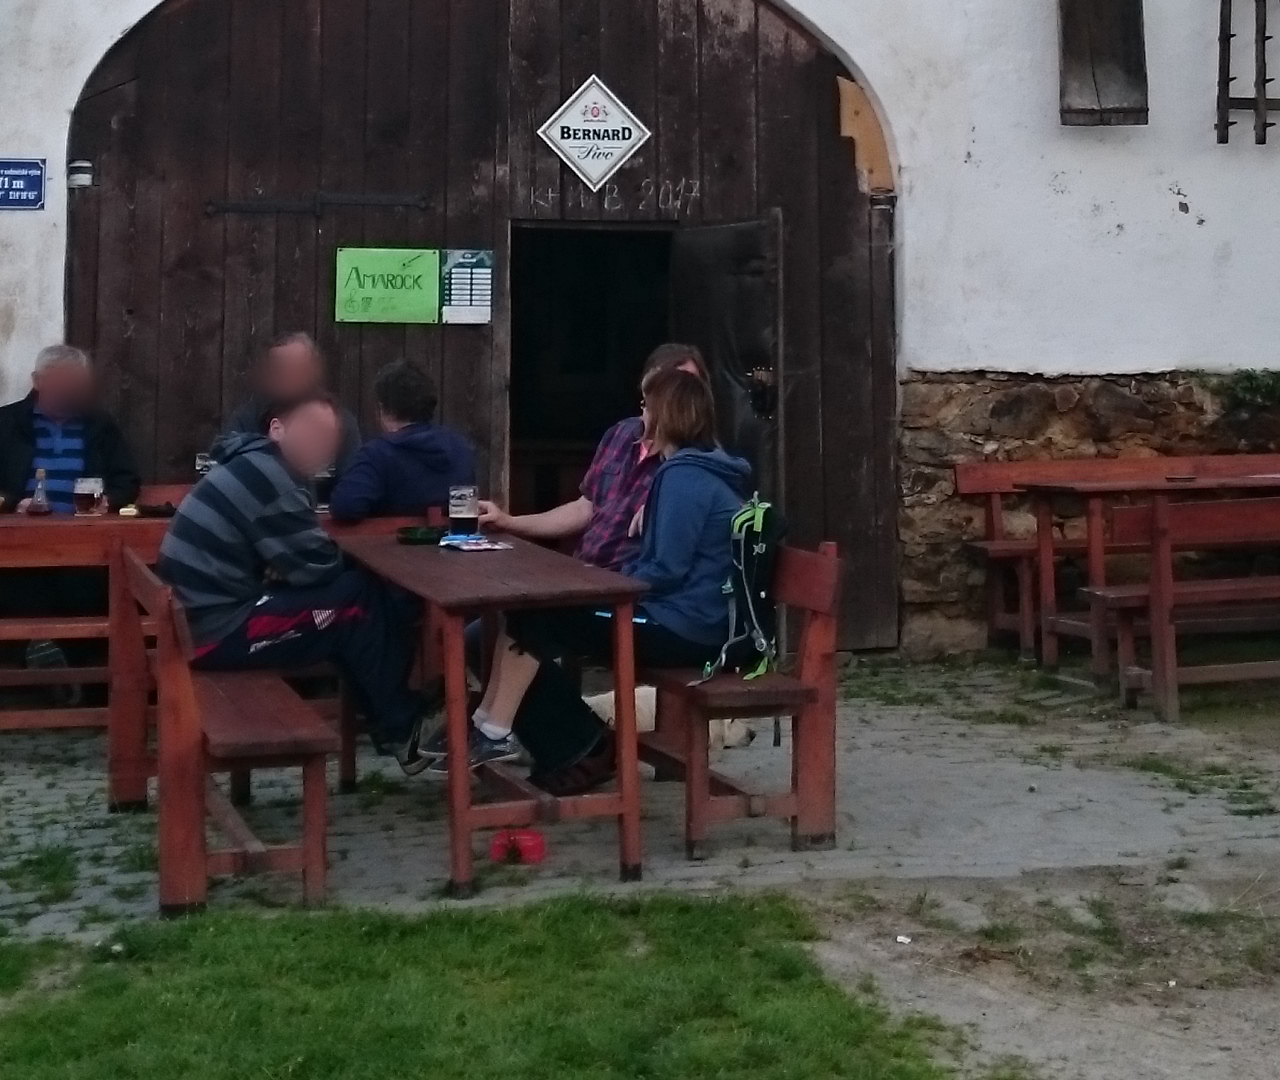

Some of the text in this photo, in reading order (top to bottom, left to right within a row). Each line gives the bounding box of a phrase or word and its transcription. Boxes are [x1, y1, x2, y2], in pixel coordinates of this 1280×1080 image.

[559, 125, 633, 141] BERNARD
[577, 143, 614, 160] Pivo
[11, 180, 25, 189] m
